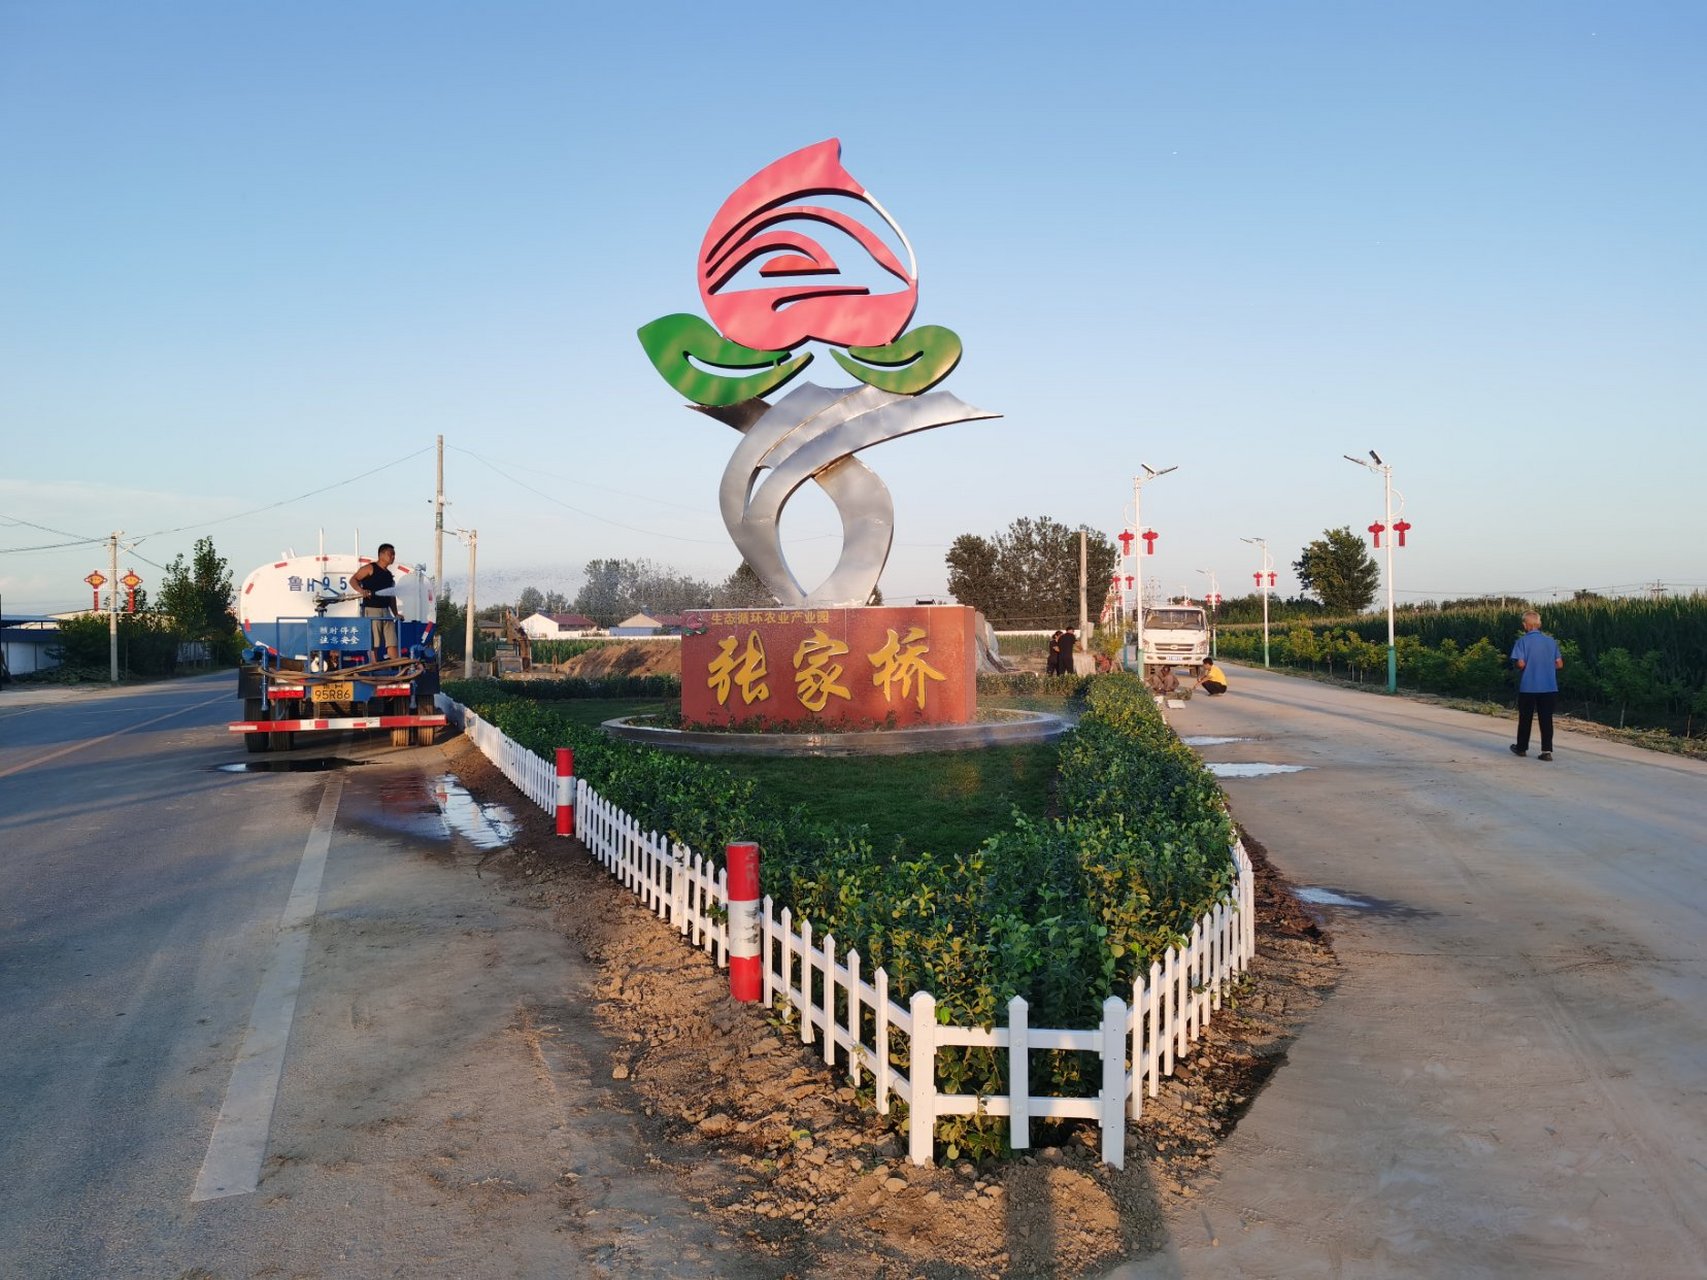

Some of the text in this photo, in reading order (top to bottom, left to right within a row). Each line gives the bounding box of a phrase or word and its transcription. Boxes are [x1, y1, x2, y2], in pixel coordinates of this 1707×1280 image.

[711, 610, 830, 625] 生态循环农业产业园
[707, 629, 947, 712] 张家桥
[315, 690, 351, 699] 95R86
